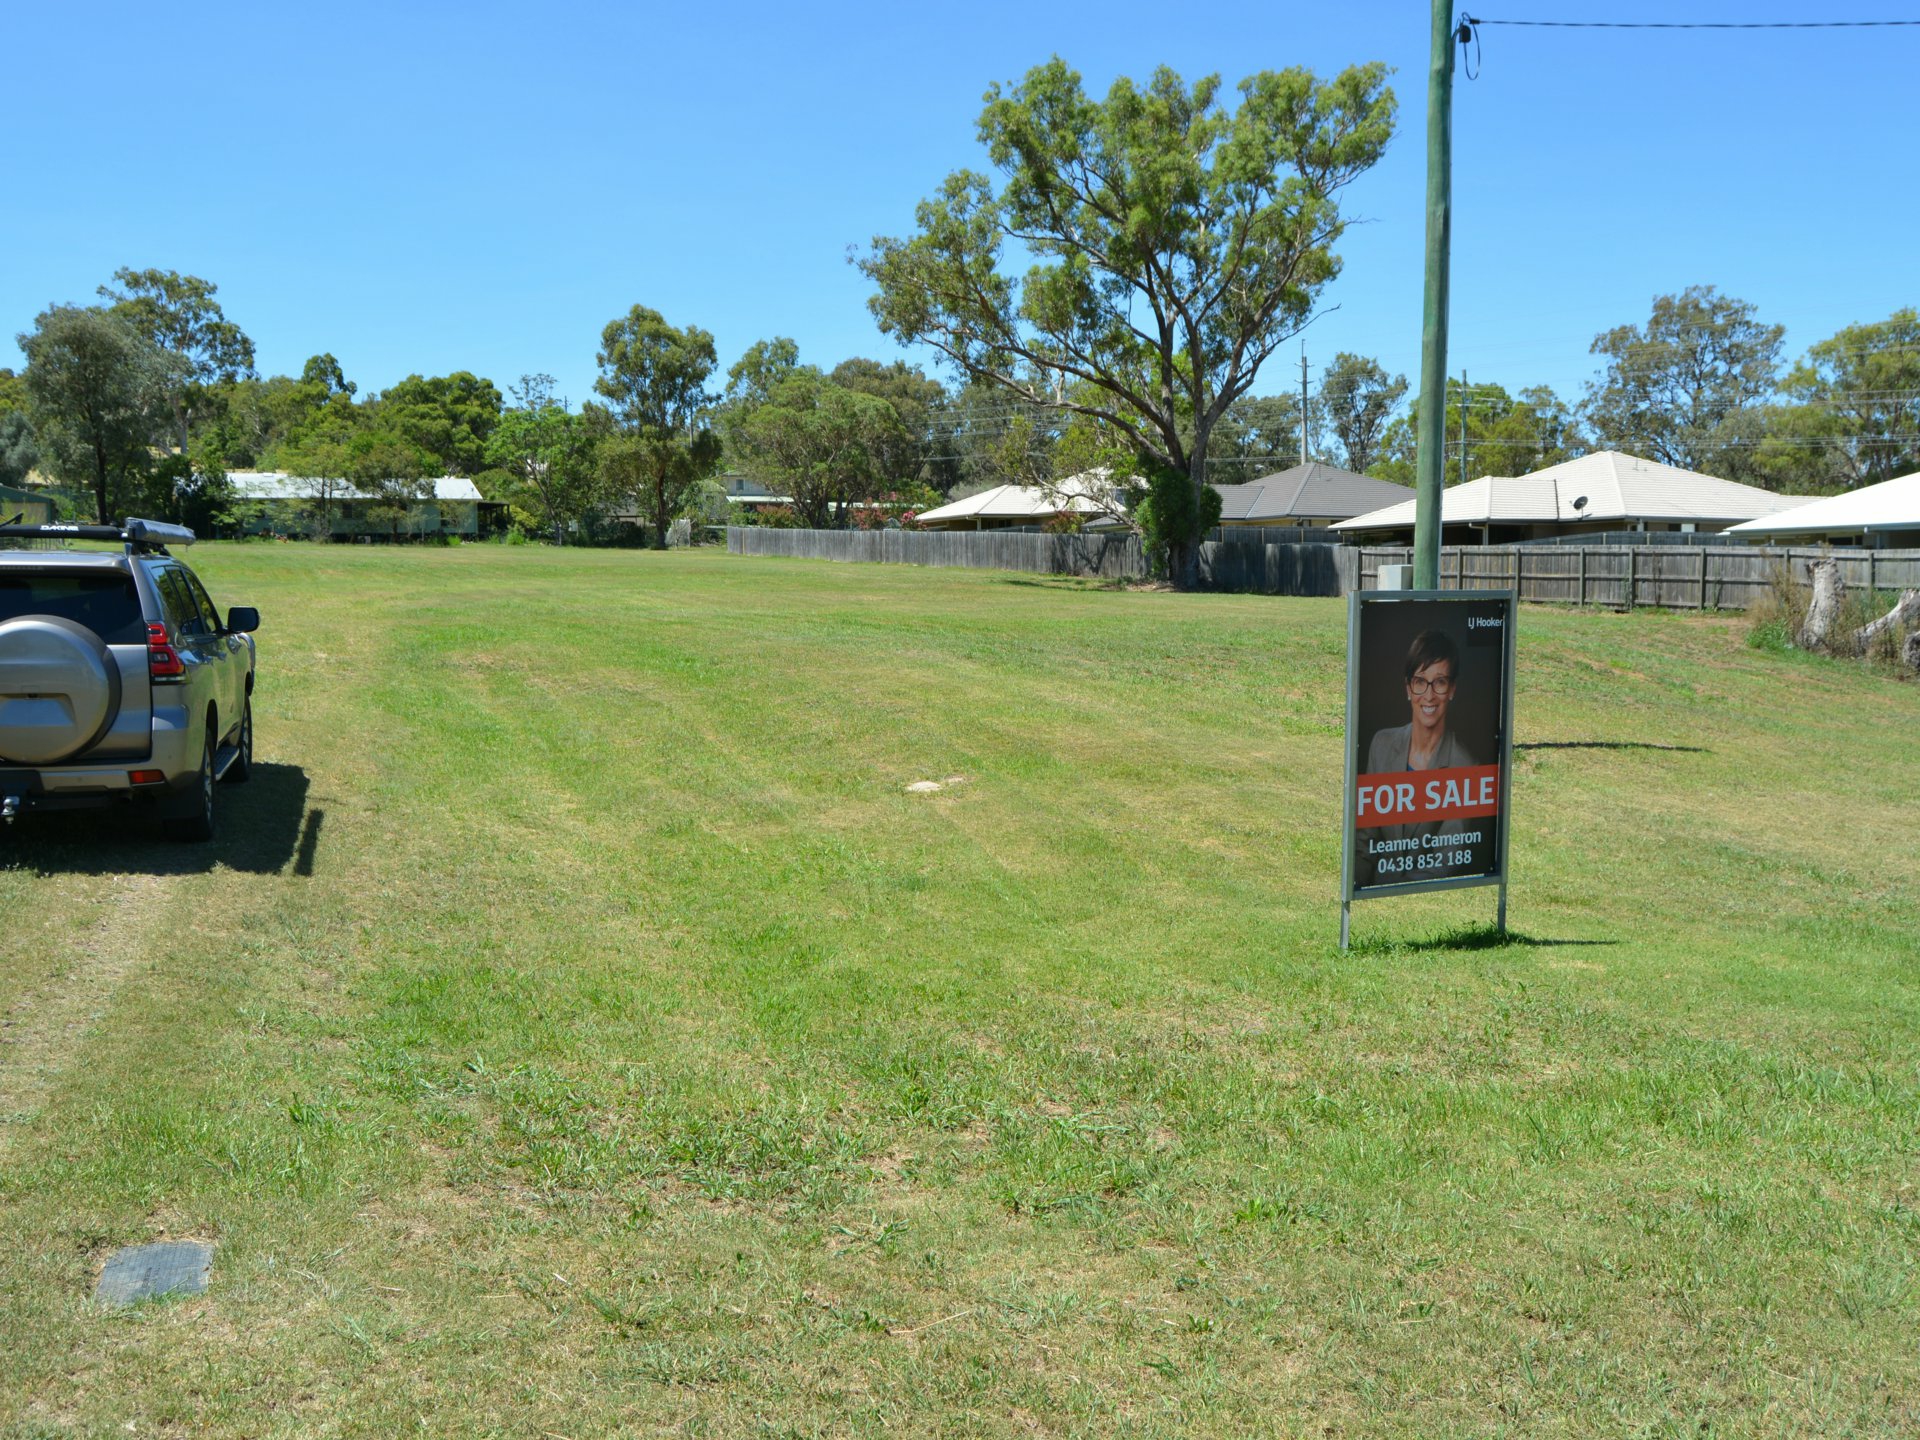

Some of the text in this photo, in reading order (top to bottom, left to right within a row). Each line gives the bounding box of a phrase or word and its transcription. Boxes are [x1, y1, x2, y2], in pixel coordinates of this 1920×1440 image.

[1468, 617, 1503, 630] LJ Hooker
[1357, 776, 1495, 816] FOR SALE
[1369, 831, 1481, 854] Leanne Cameron
[1378, 849, 1472, 873] 0438 852 188
